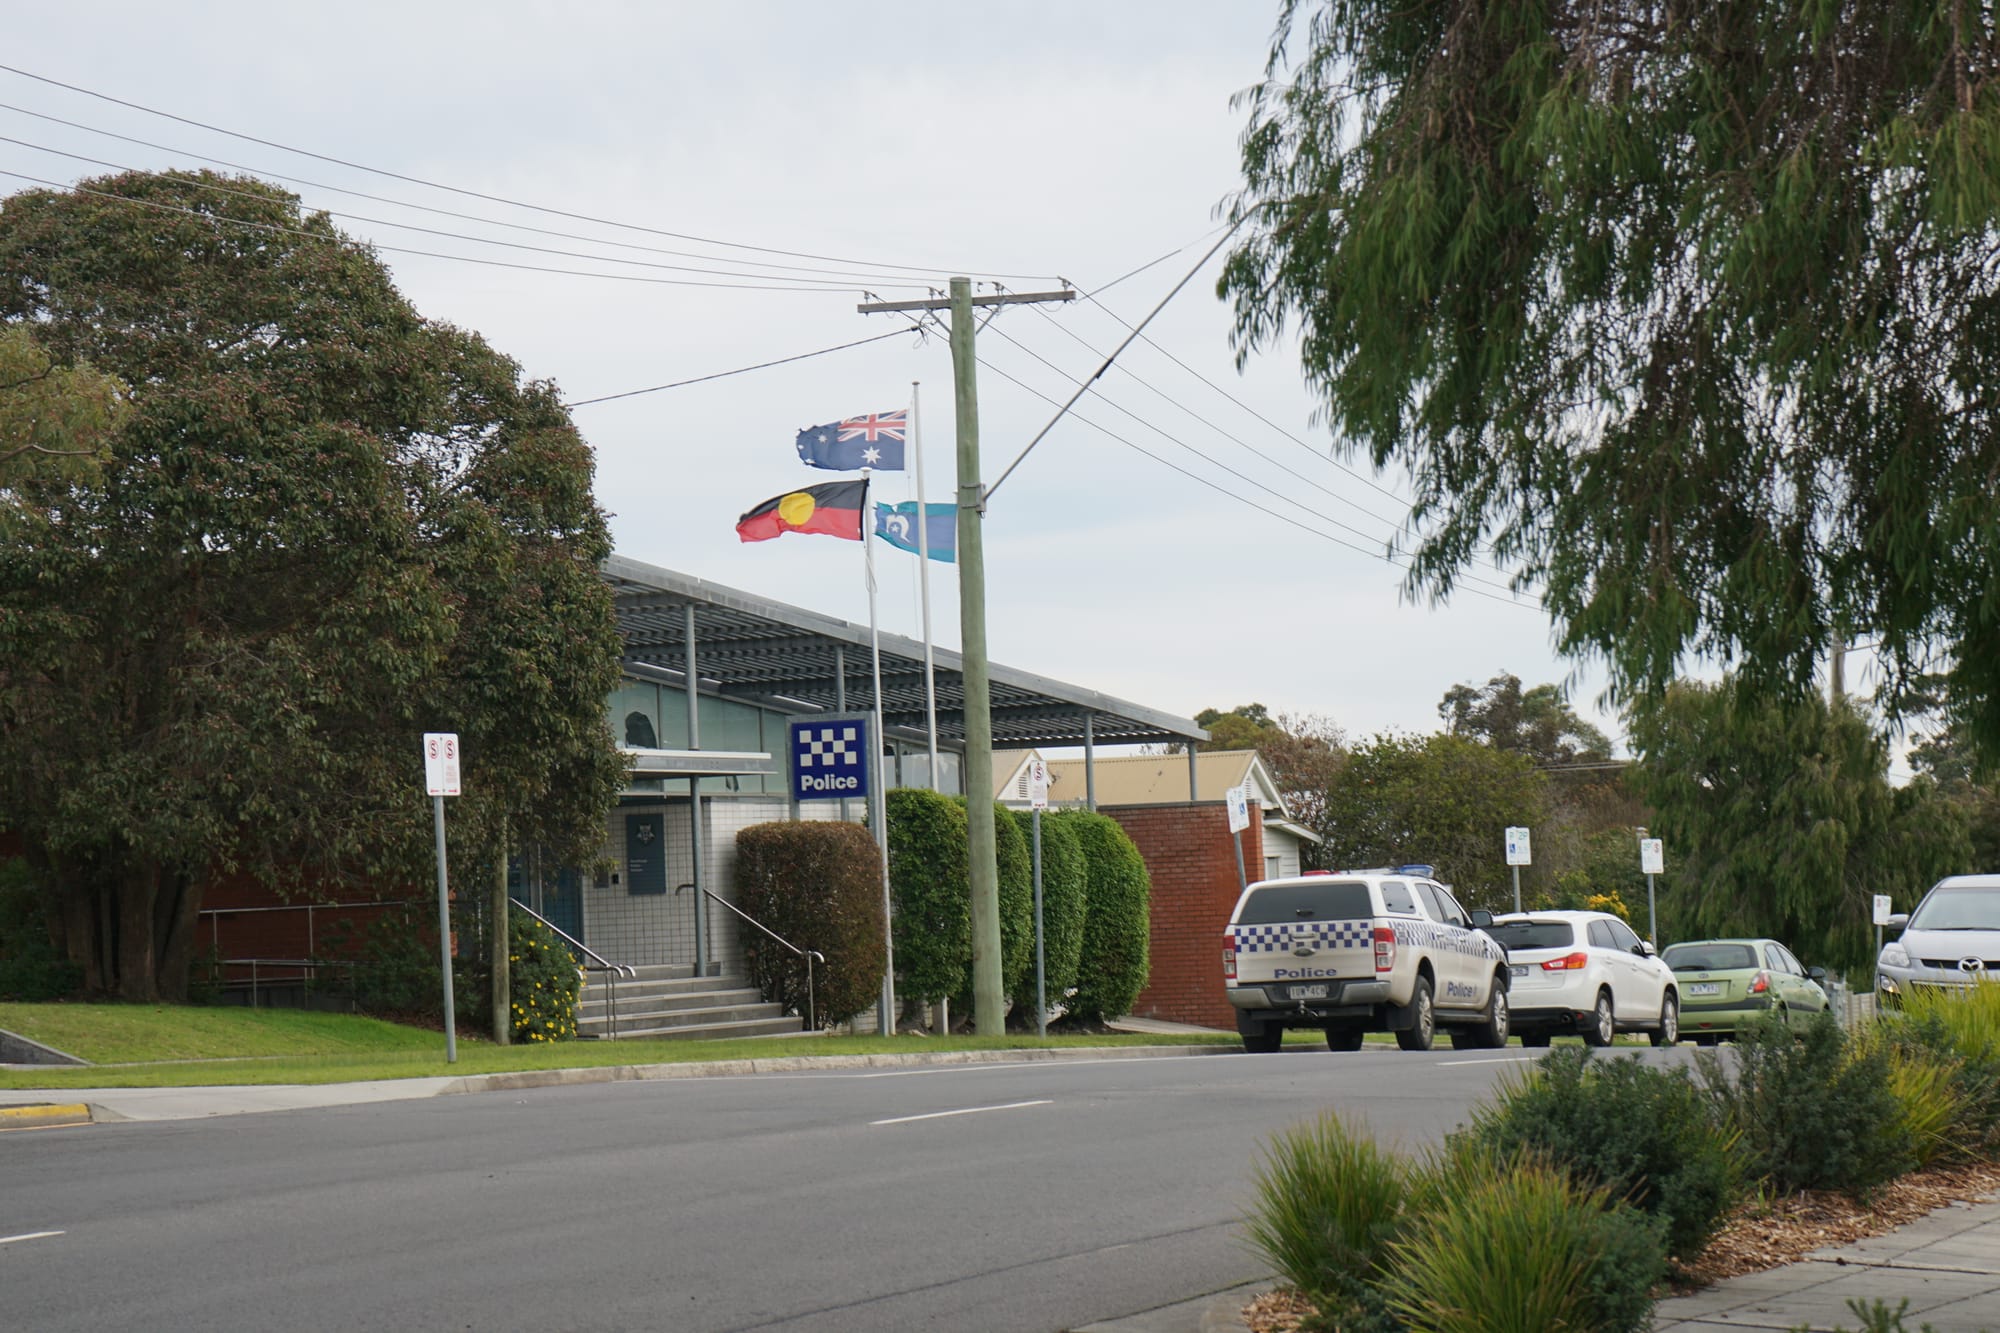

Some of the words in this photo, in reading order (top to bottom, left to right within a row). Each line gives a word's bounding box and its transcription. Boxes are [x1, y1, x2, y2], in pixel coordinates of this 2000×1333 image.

[801, 773, 858, 791] Police
[1274, 967, 1337, 979] Police
[1446, 981, 1473, 998] Police
